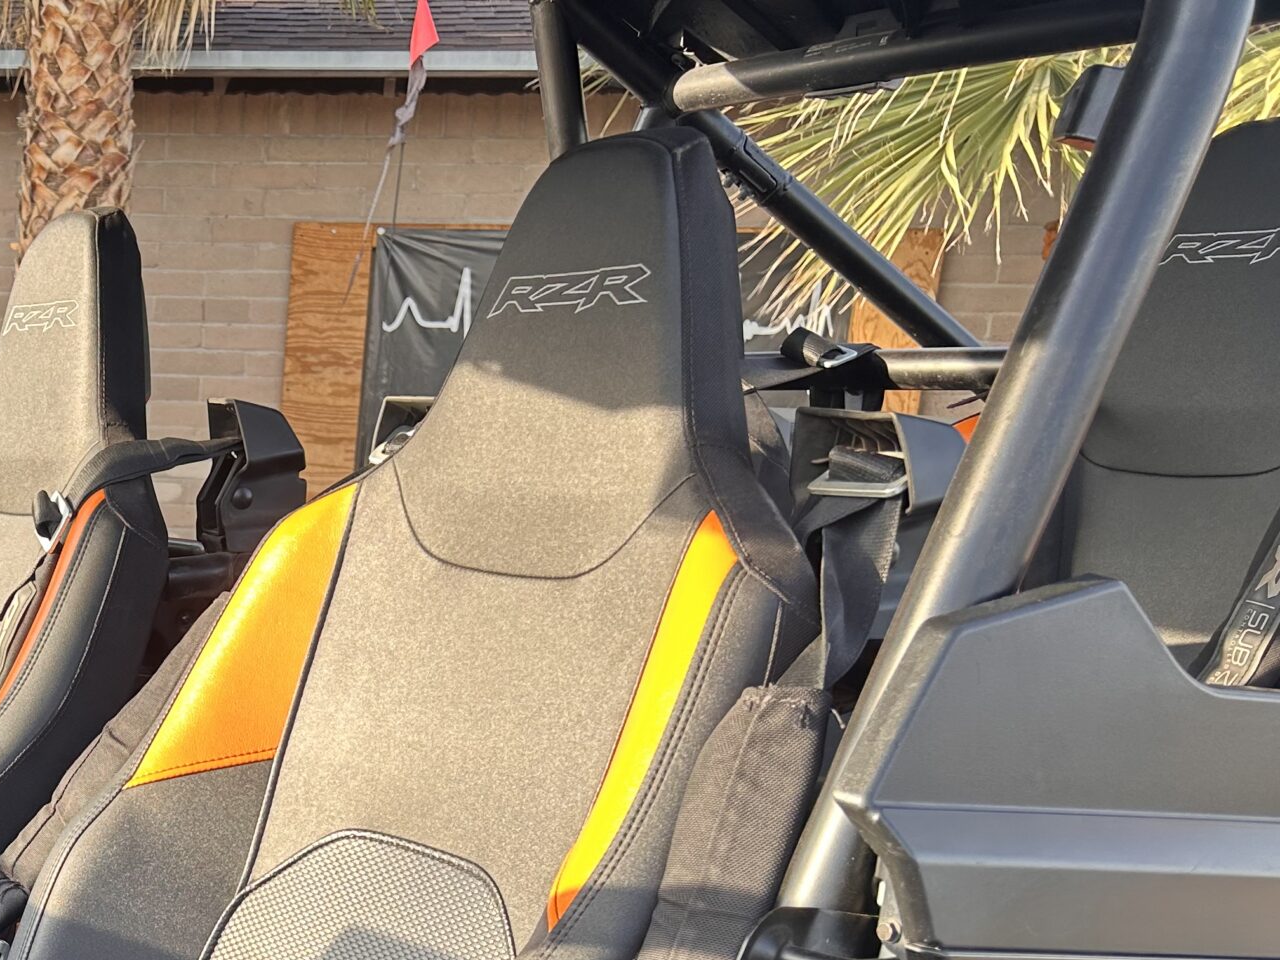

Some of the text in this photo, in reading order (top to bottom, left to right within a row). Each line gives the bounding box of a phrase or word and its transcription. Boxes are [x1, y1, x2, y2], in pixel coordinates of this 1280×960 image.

[1158, 227, 1280, 265] RZ
[486, 263, 651, 319] RZR
[2, 299, 79, 336] RZR
[1231, 610, 1270, 667] SUB
